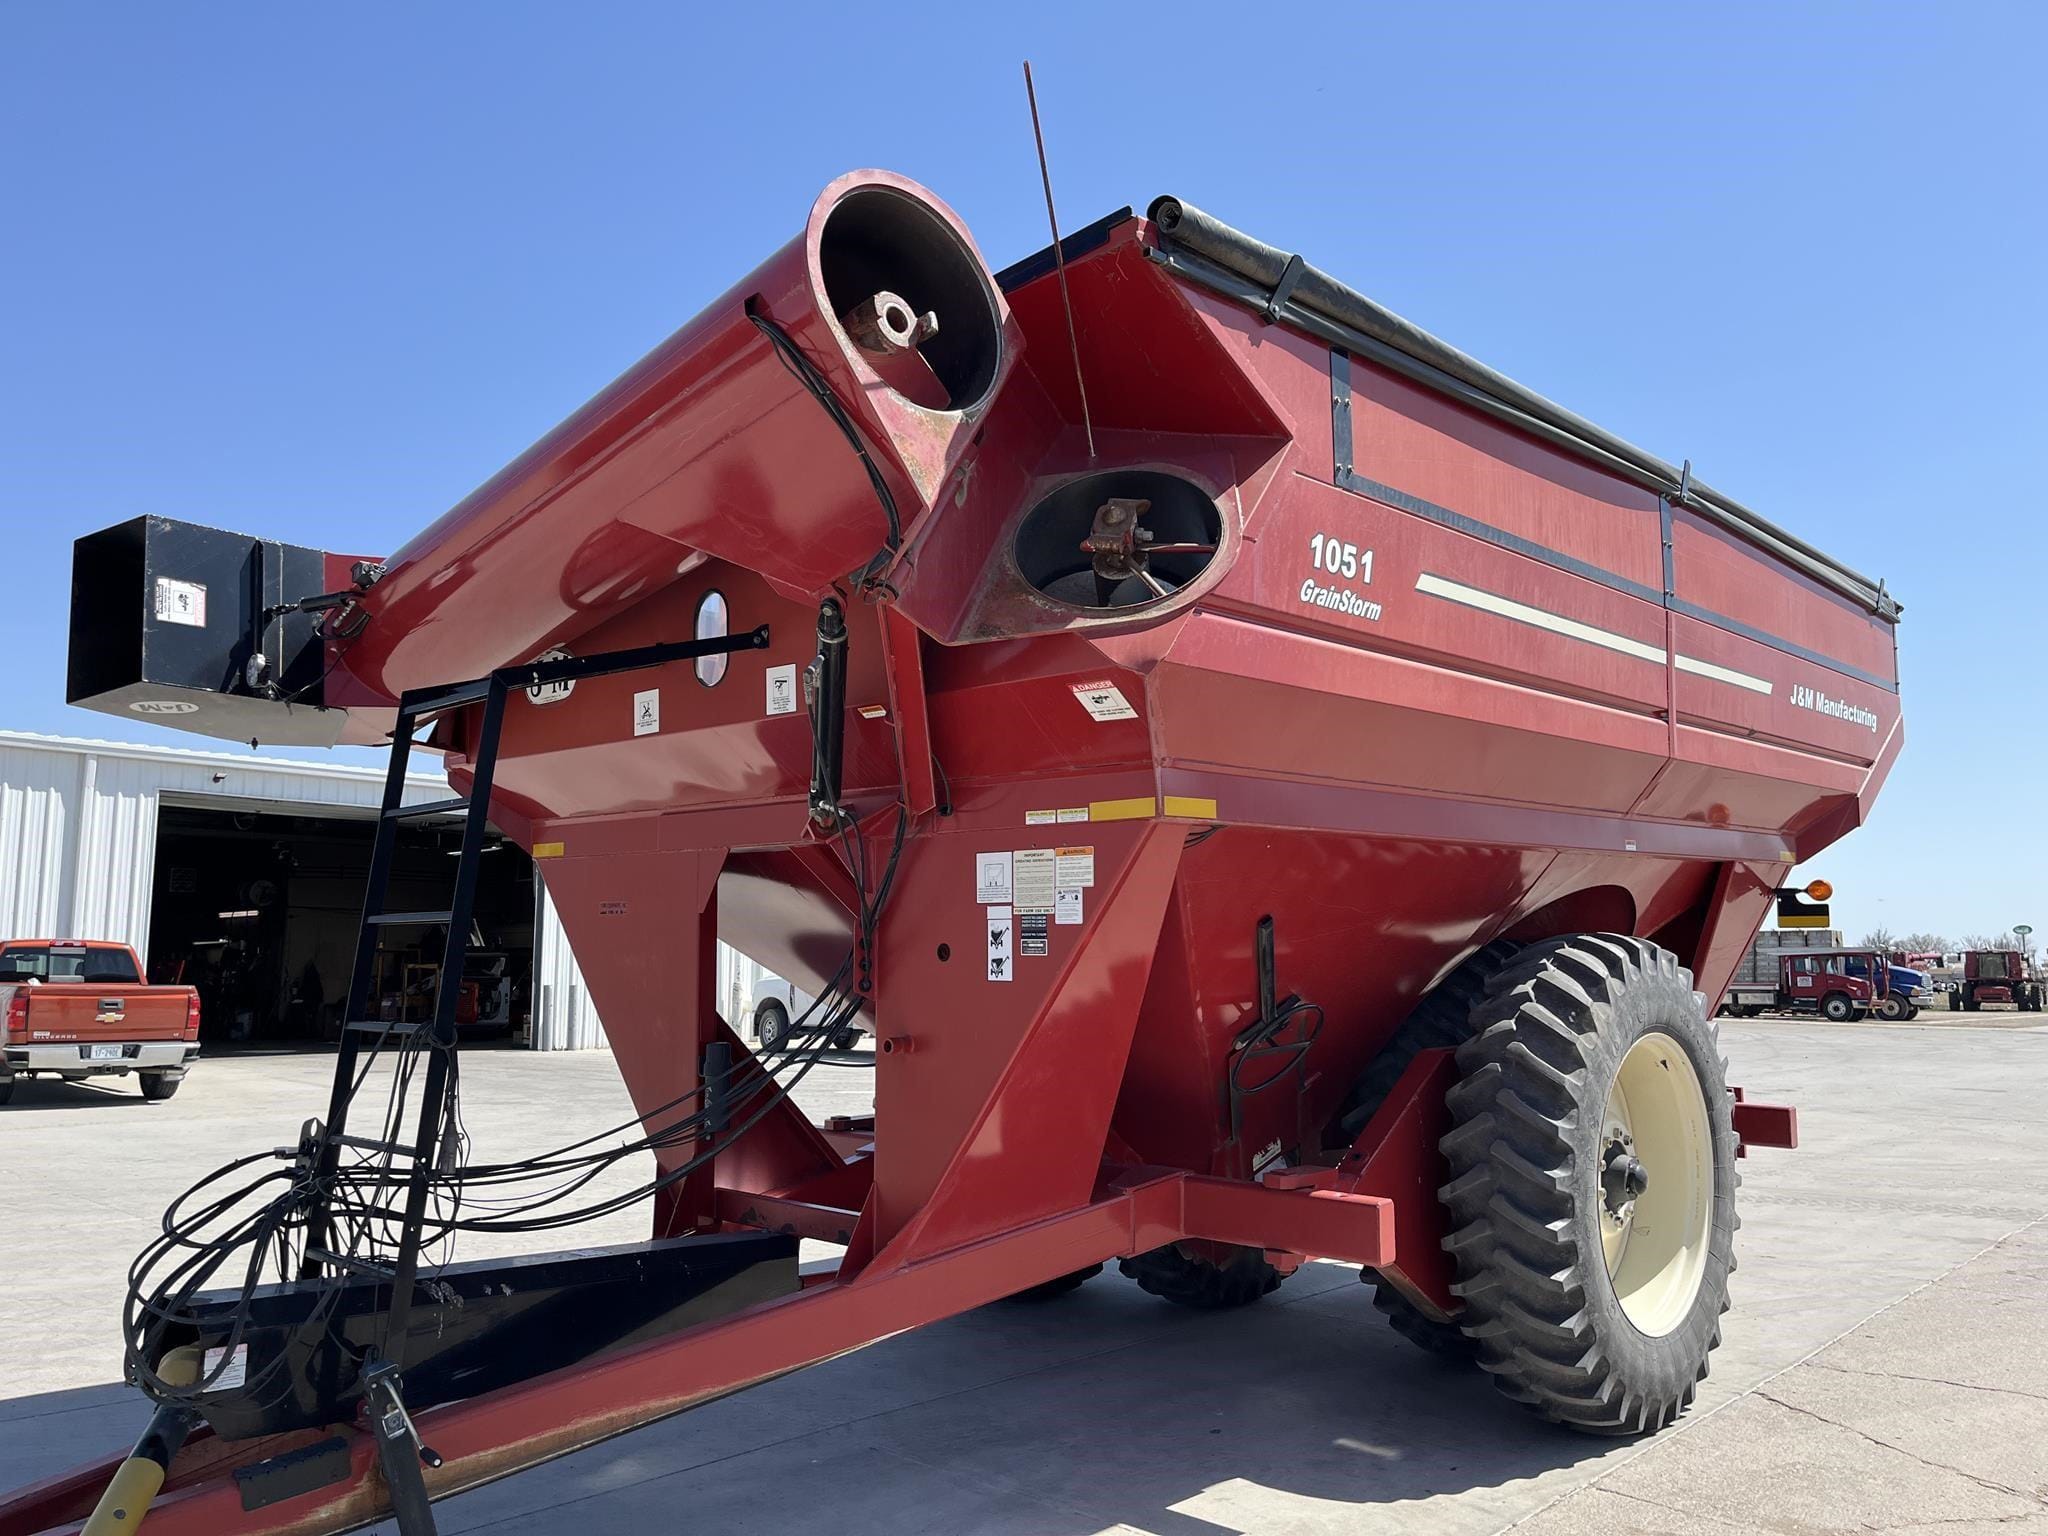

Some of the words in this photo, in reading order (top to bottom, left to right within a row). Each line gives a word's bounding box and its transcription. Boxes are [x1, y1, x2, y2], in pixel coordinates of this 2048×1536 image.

[1310, 533, 1373, 584] 1051
[1300, 578, 1382, 621] GrainStorm
[1077, 680, 1114, 691] DANGER
[1790, 684, 1814, 710] J&M
[1816, 691, 1877, 733] Manufacturing
